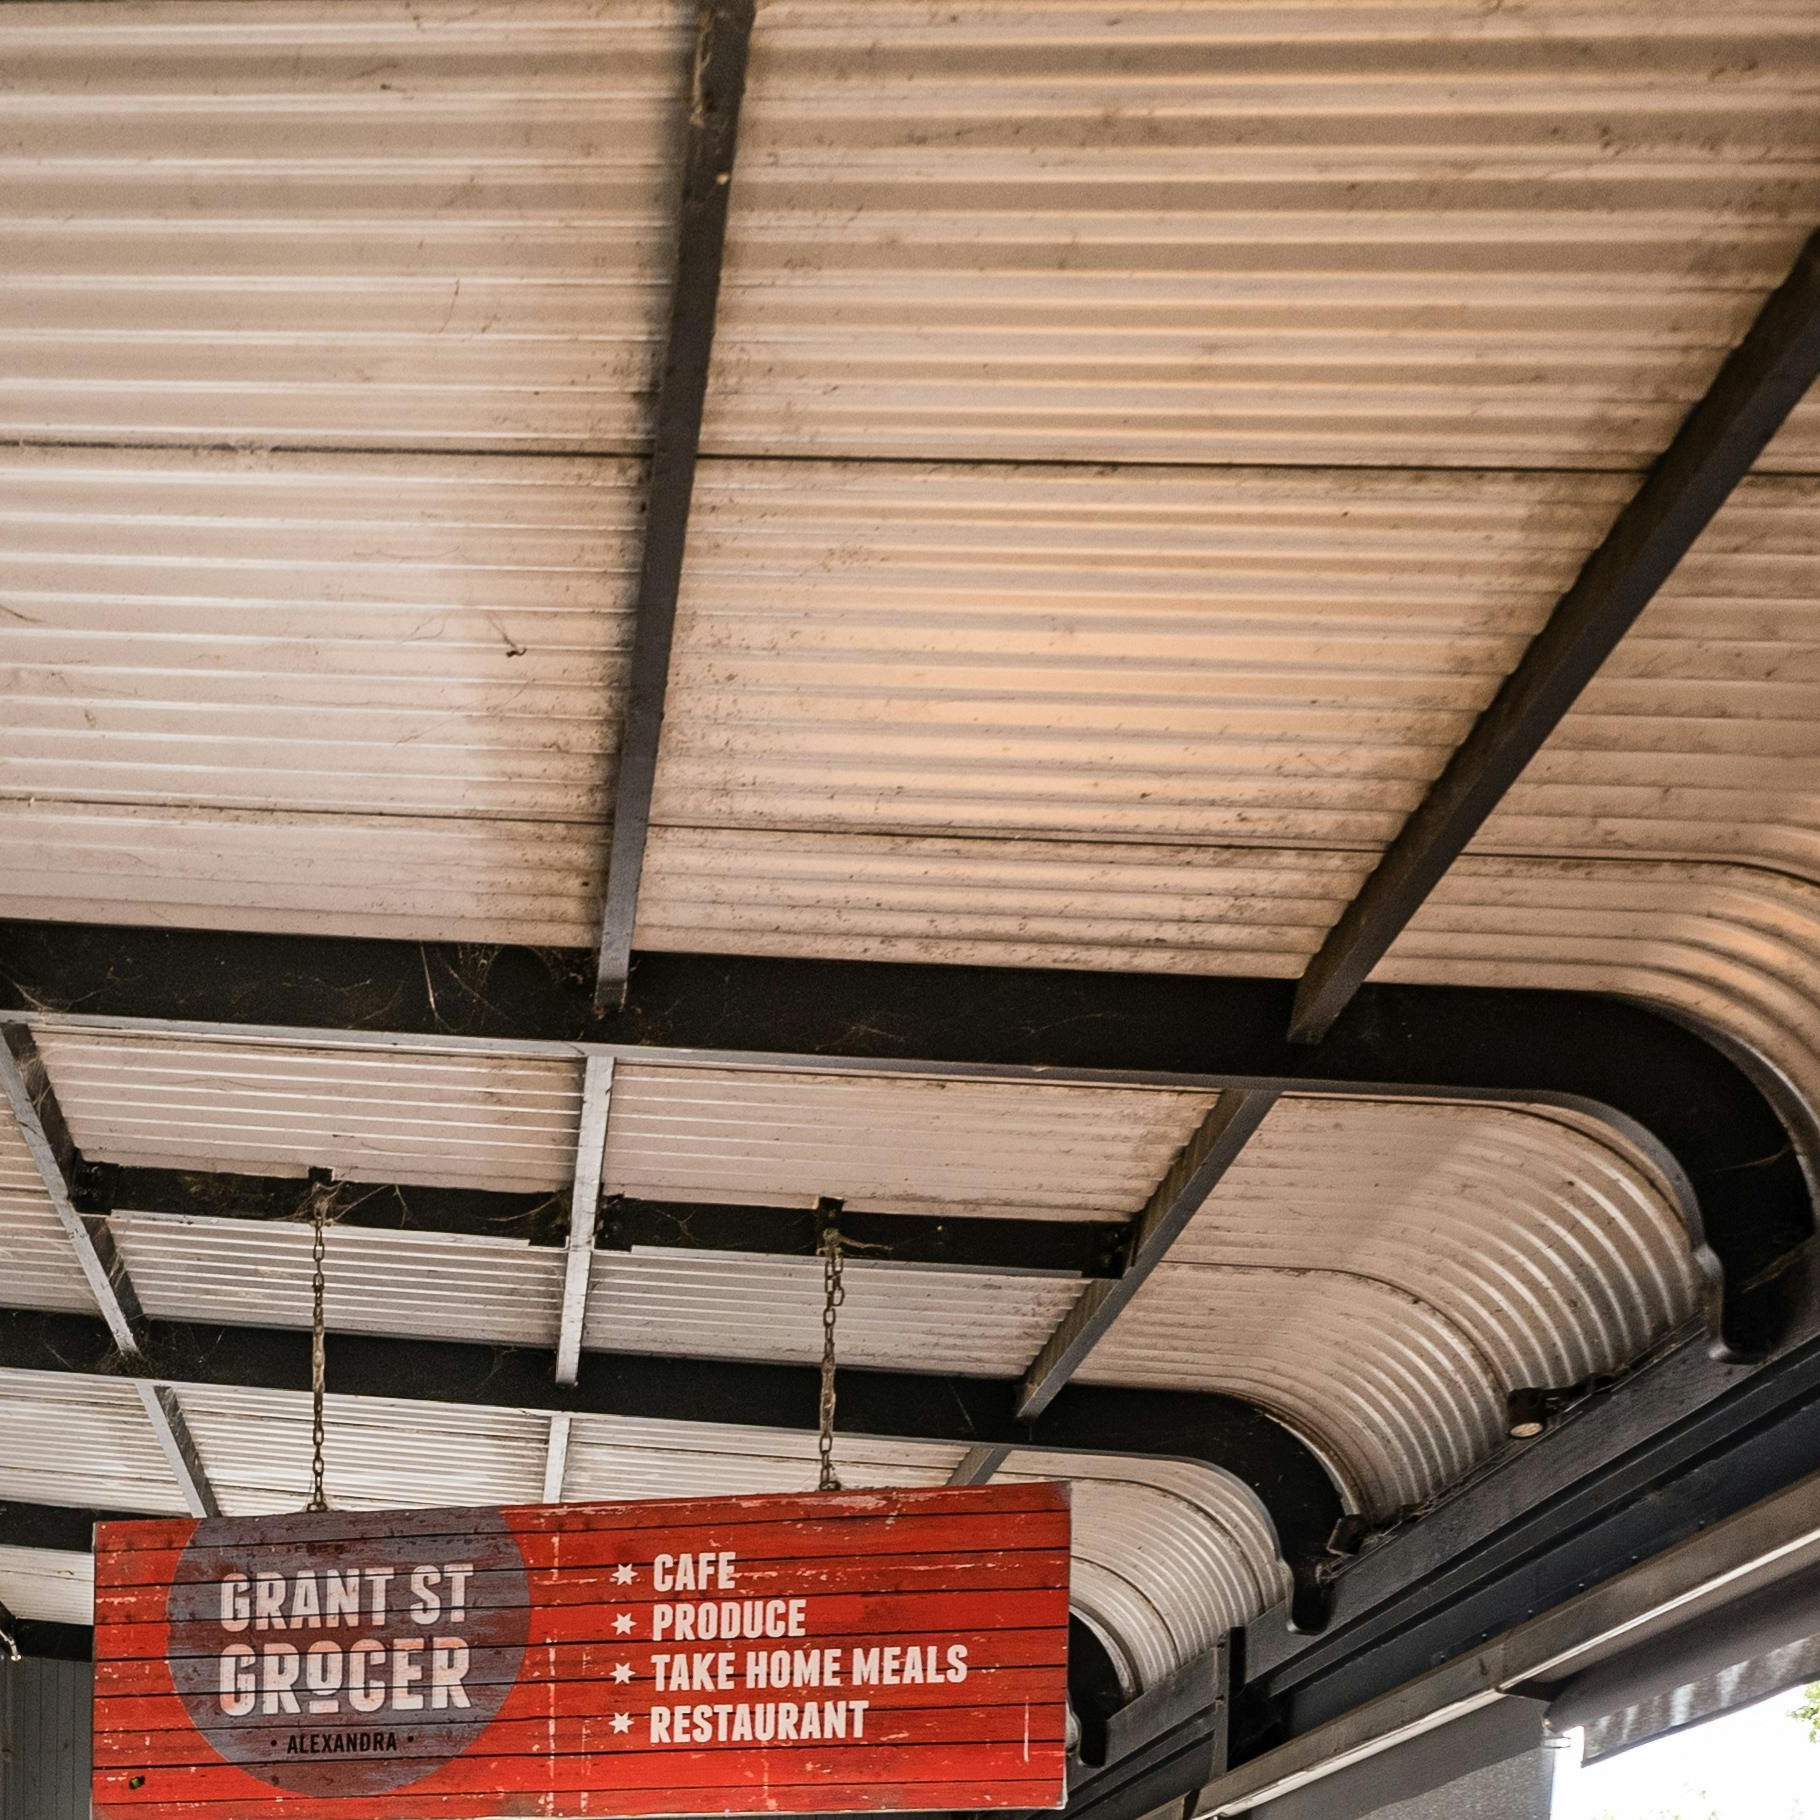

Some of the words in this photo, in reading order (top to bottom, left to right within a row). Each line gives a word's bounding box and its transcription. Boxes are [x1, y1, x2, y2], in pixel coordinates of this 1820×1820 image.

[653, 1551, 737, 1592] CAFE
[219, 1566, 395, 1633] GRANT
[410, 1563, 474, 1625] ST
[652, 1599, 807, 1641] PRODUCE
[219, 1636, 473, 1717] GROCER
[651, 1651, 736, 1692] TAKE
[746, 1647, 841, 1689] HOME
[852, 1644, 968, 1686] MEALS
[286, 1731, 398, 1754] ALEXANDRA
[650, 1700, 870, 1744] RESTAURANT
